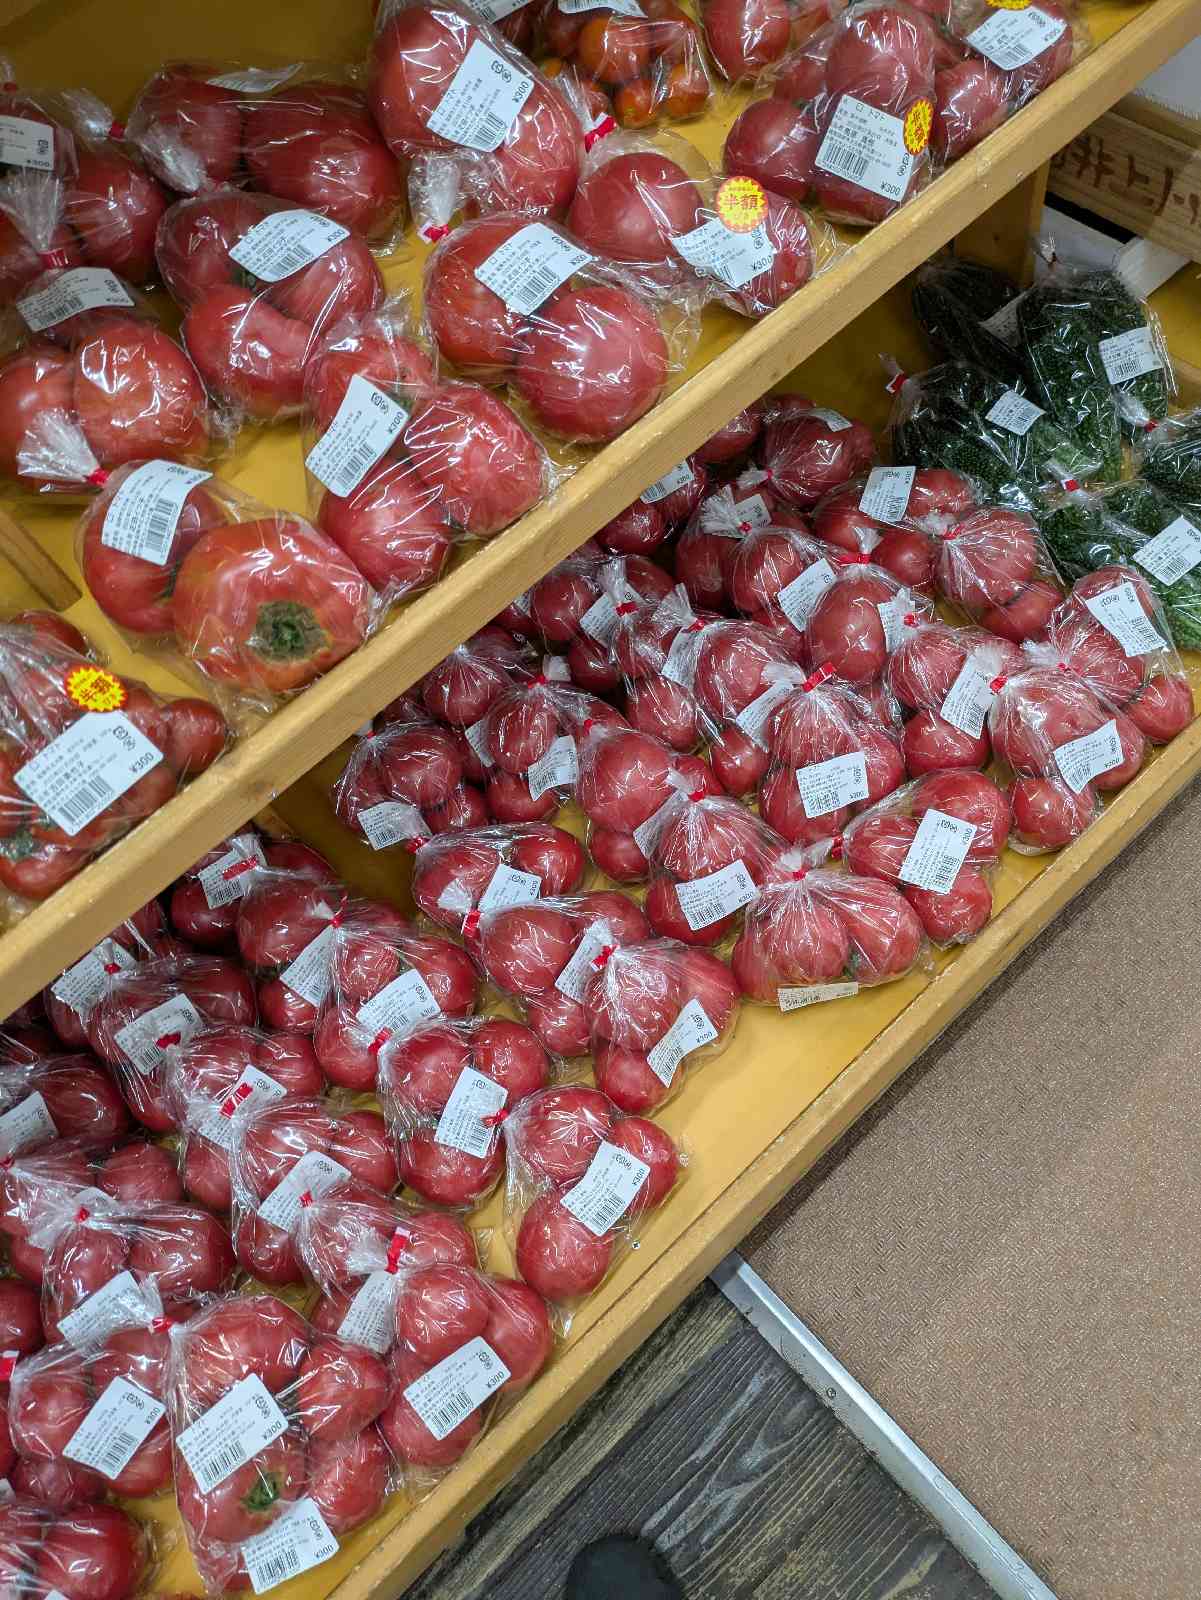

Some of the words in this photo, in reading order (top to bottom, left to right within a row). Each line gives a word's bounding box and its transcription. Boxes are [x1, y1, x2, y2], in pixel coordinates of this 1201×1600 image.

[512, 81, 529, 103] ¥300
[880, 181, 902, 195] ¥300
[752, 255, 772, 270] ¥300
[129, 751, 154, 772] ¥300
[486, 1370, 505, 1389] ¥300
[263, 1420, 282, 1440] ¥300
